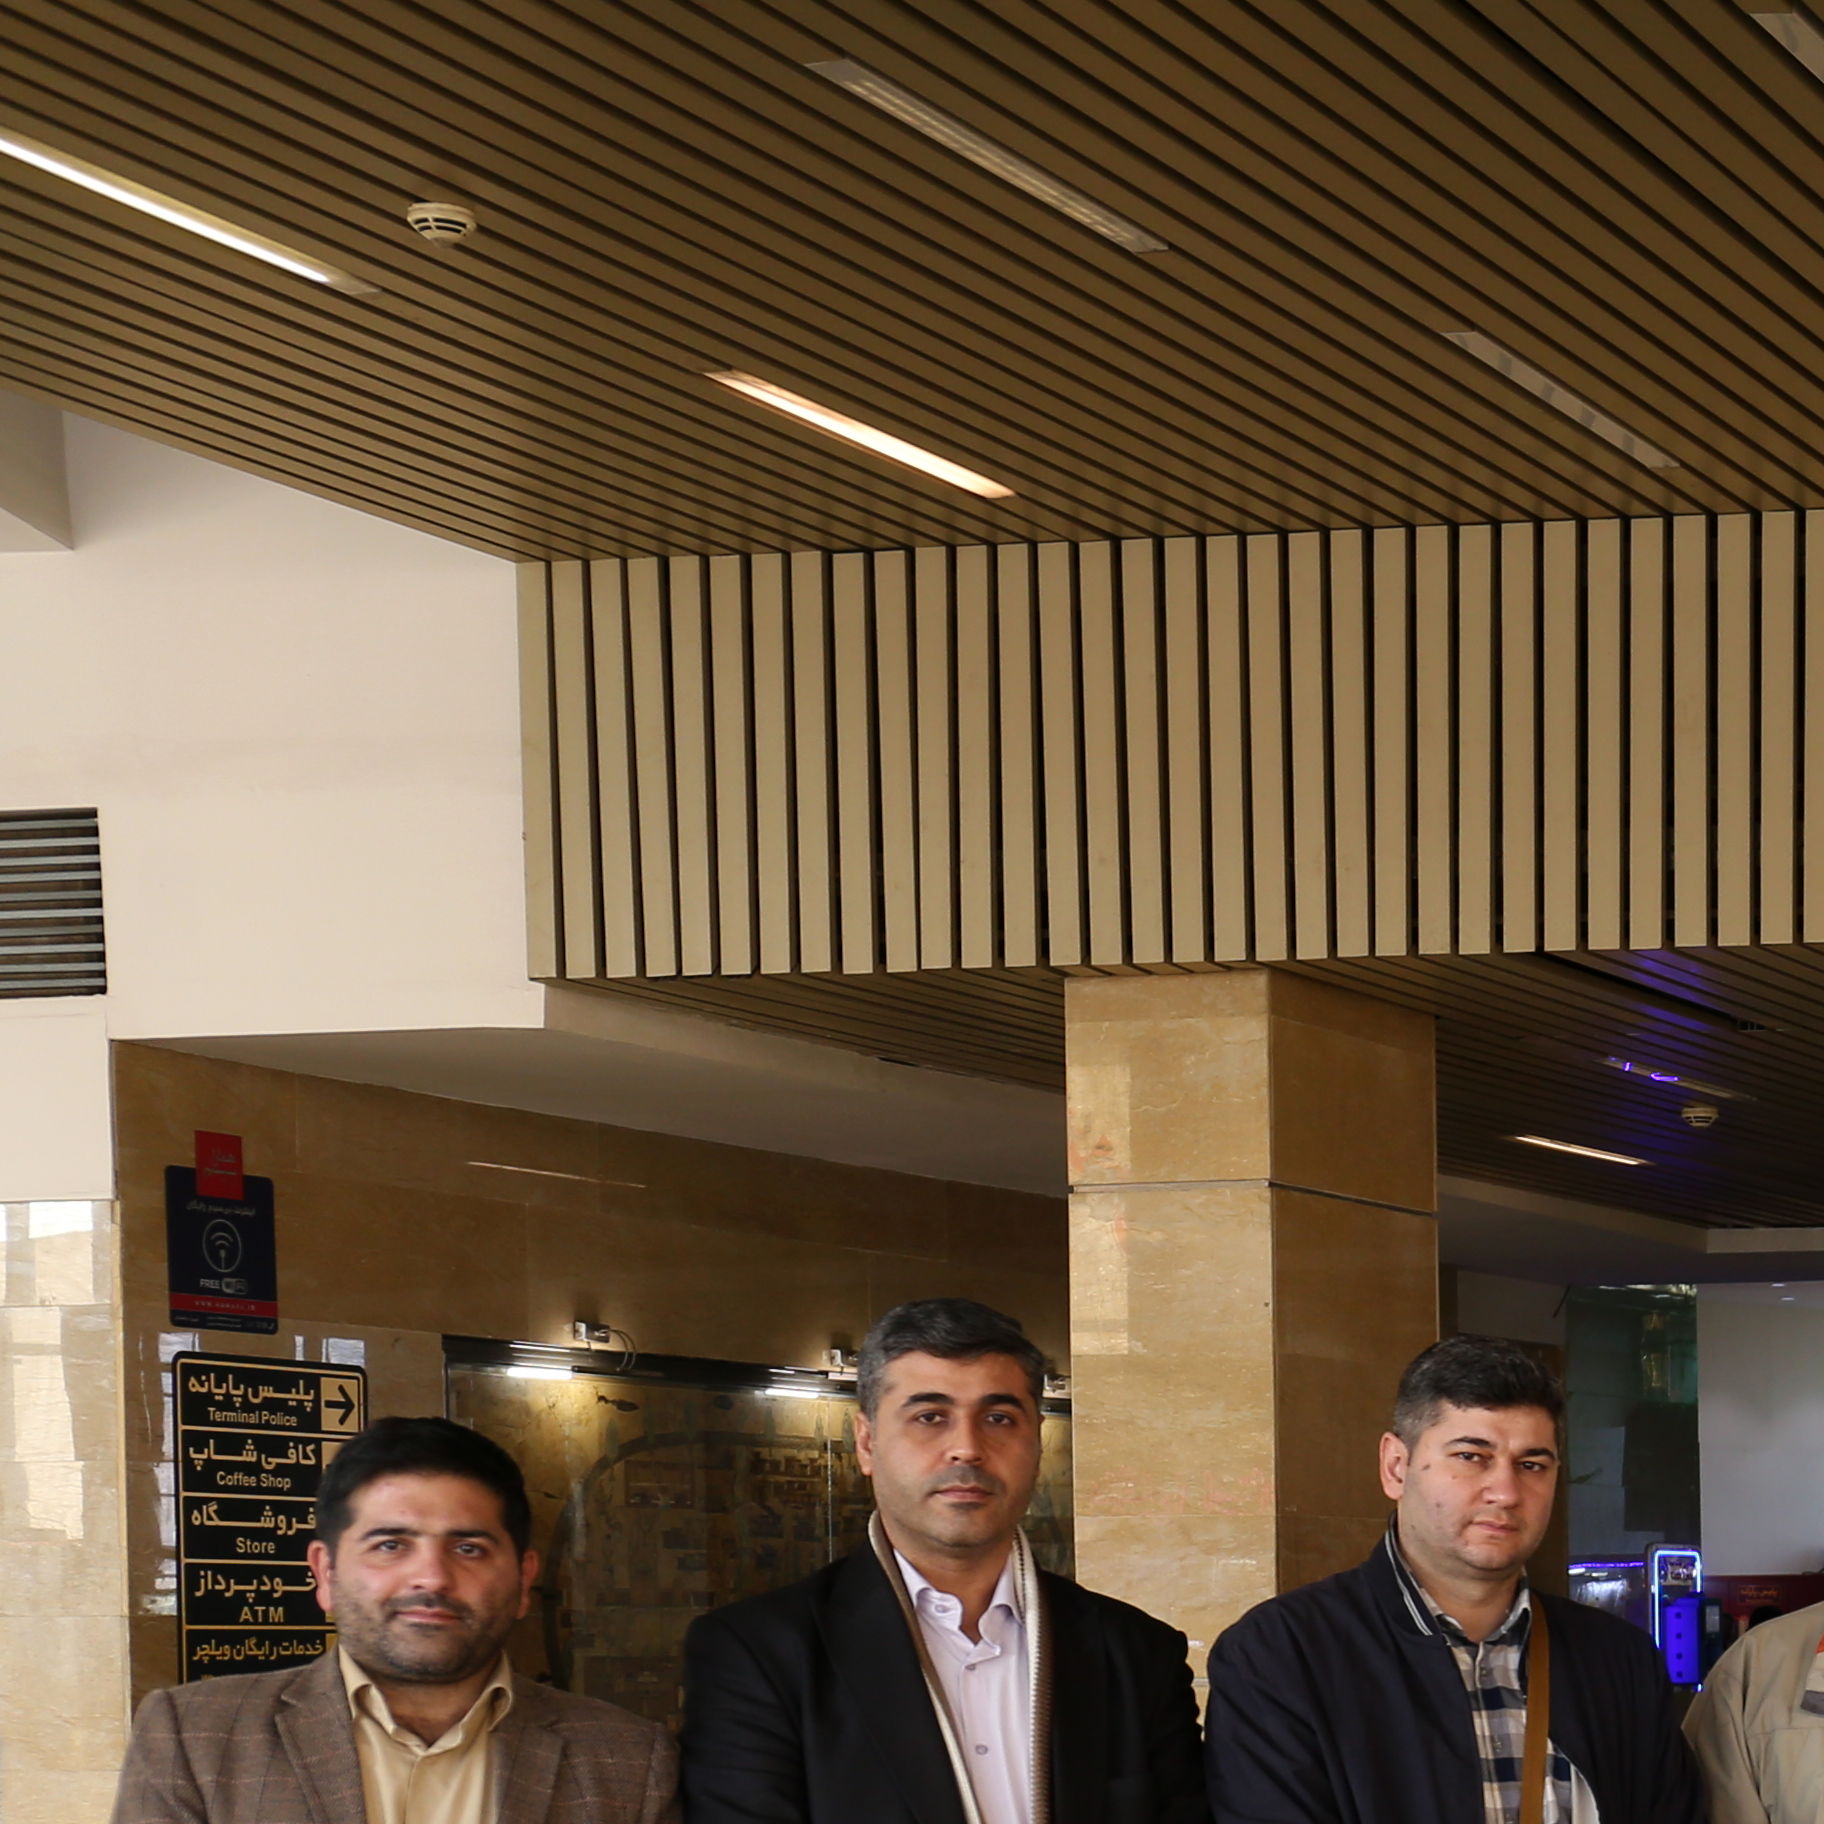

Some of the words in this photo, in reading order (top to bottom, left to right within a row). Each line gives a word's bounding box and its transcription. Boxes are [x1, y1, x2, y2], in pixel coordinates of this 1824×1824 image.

[189, 1373, 244, 1407] پایانه
[248, 1379, 315, 1412] پلیس
[207, 1407, 259, 1424] Terminal
[261, 1411, 298, 1426] Police
[189, 1439, 257, 1471] شاپ
[261, 1442, 316, 1470] کافی
[216, 1471, 257, 1486] Coffee
[260, 1473, 291, 1491] Shop
[191, 1501, 317, 1536] فروشگاه
[236, 1537, 276, 1554] Store
[194, 1570, 317, 1603] خودپرداز
[239, 1606, 284, 1623] ATM
[192, 1639, 230, 1663] ویلچر
[233, 1637, 277, 1660] رایگان
[279, 1639, 324, 1655] خدمات
